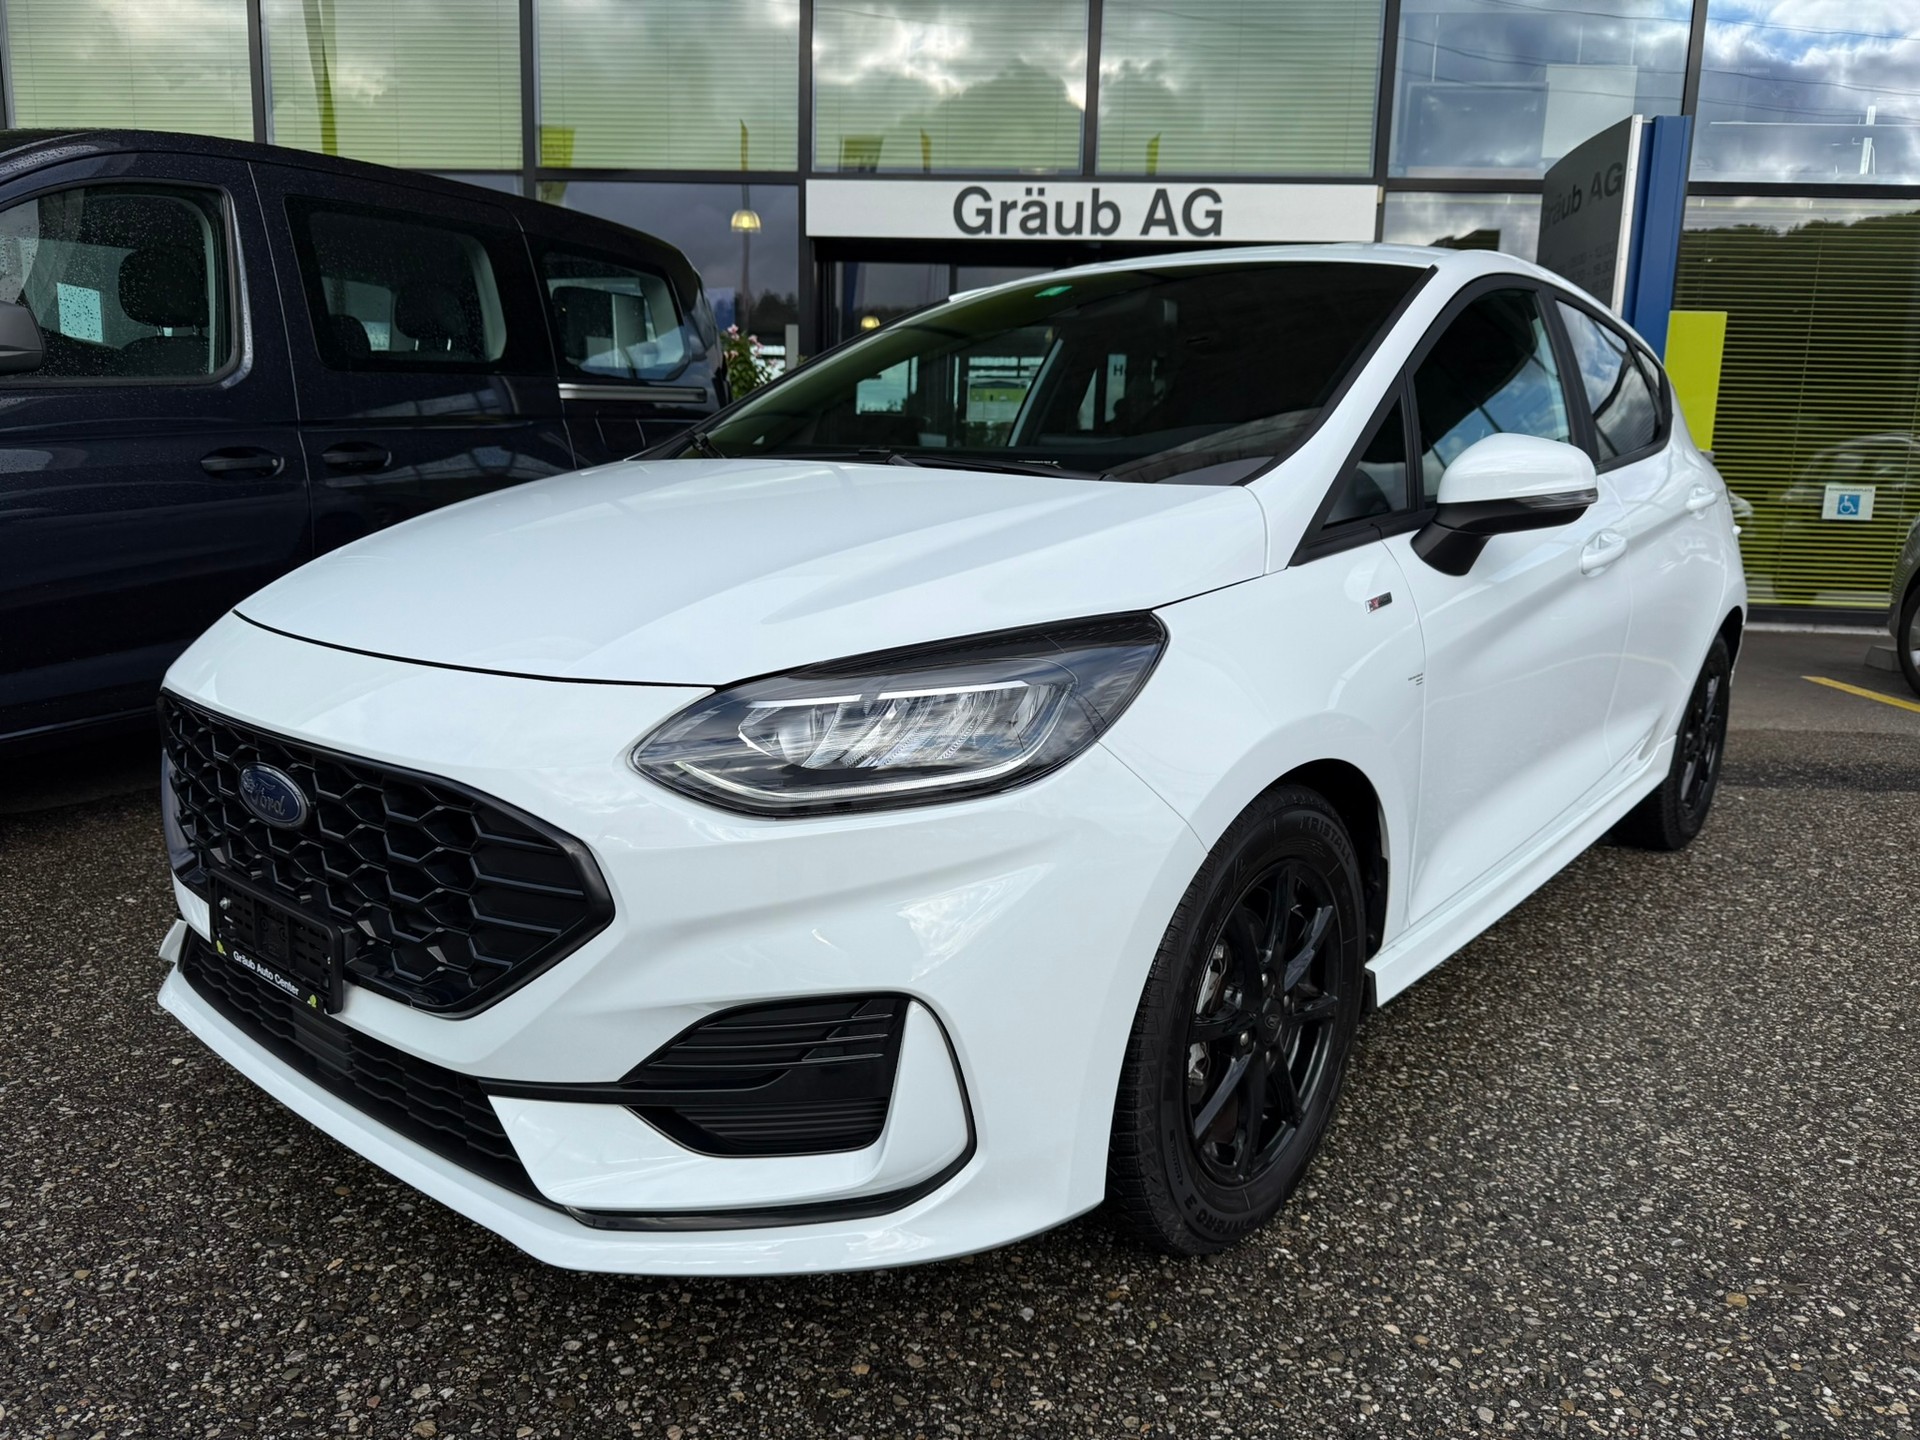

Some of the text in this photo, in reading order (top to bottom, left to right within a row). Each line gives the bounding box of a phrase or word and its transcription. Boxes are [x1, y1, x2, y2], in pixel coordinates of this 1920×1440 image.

[1589, 163, 1622, 204] AG
[953, 186, 1223, 236] Gräub AG
[250, 777, 286, 816] Ford
[232, 950, 300, 996] Gräub Auto Center
[1183, 1192, 1198, 1210] 3
